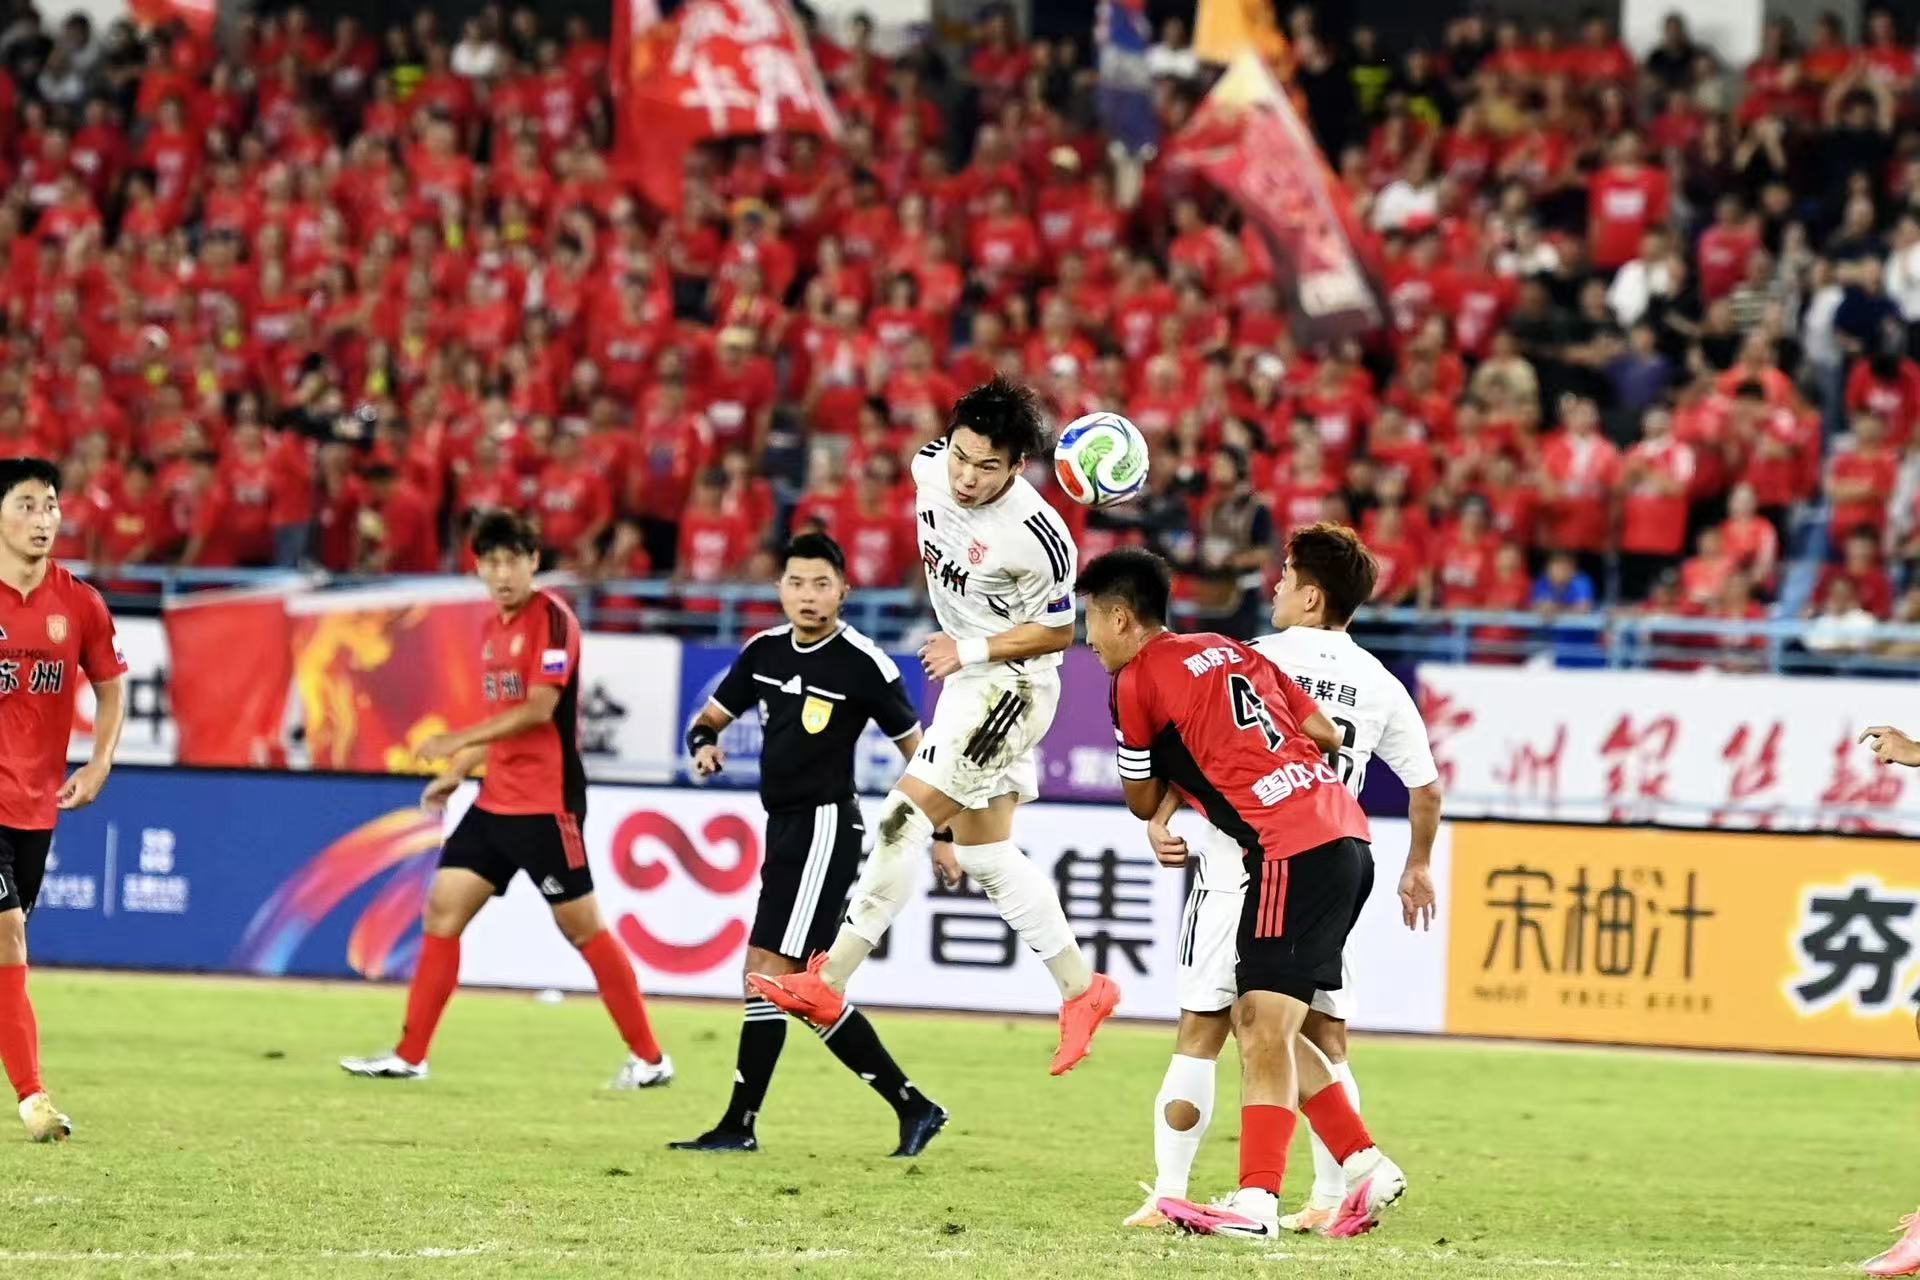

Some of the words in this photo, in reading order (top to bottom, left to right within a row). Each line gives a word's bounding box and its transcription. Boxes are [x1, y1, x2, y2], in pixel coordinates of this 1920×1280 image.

[1228, 673, 1285, 753] 4
[1294, 675, 1358, 707] 黄紫昌
[1481, 865, 1716, 982] 宋柚汁
[1796, 886, 1920, 1004] 夯
